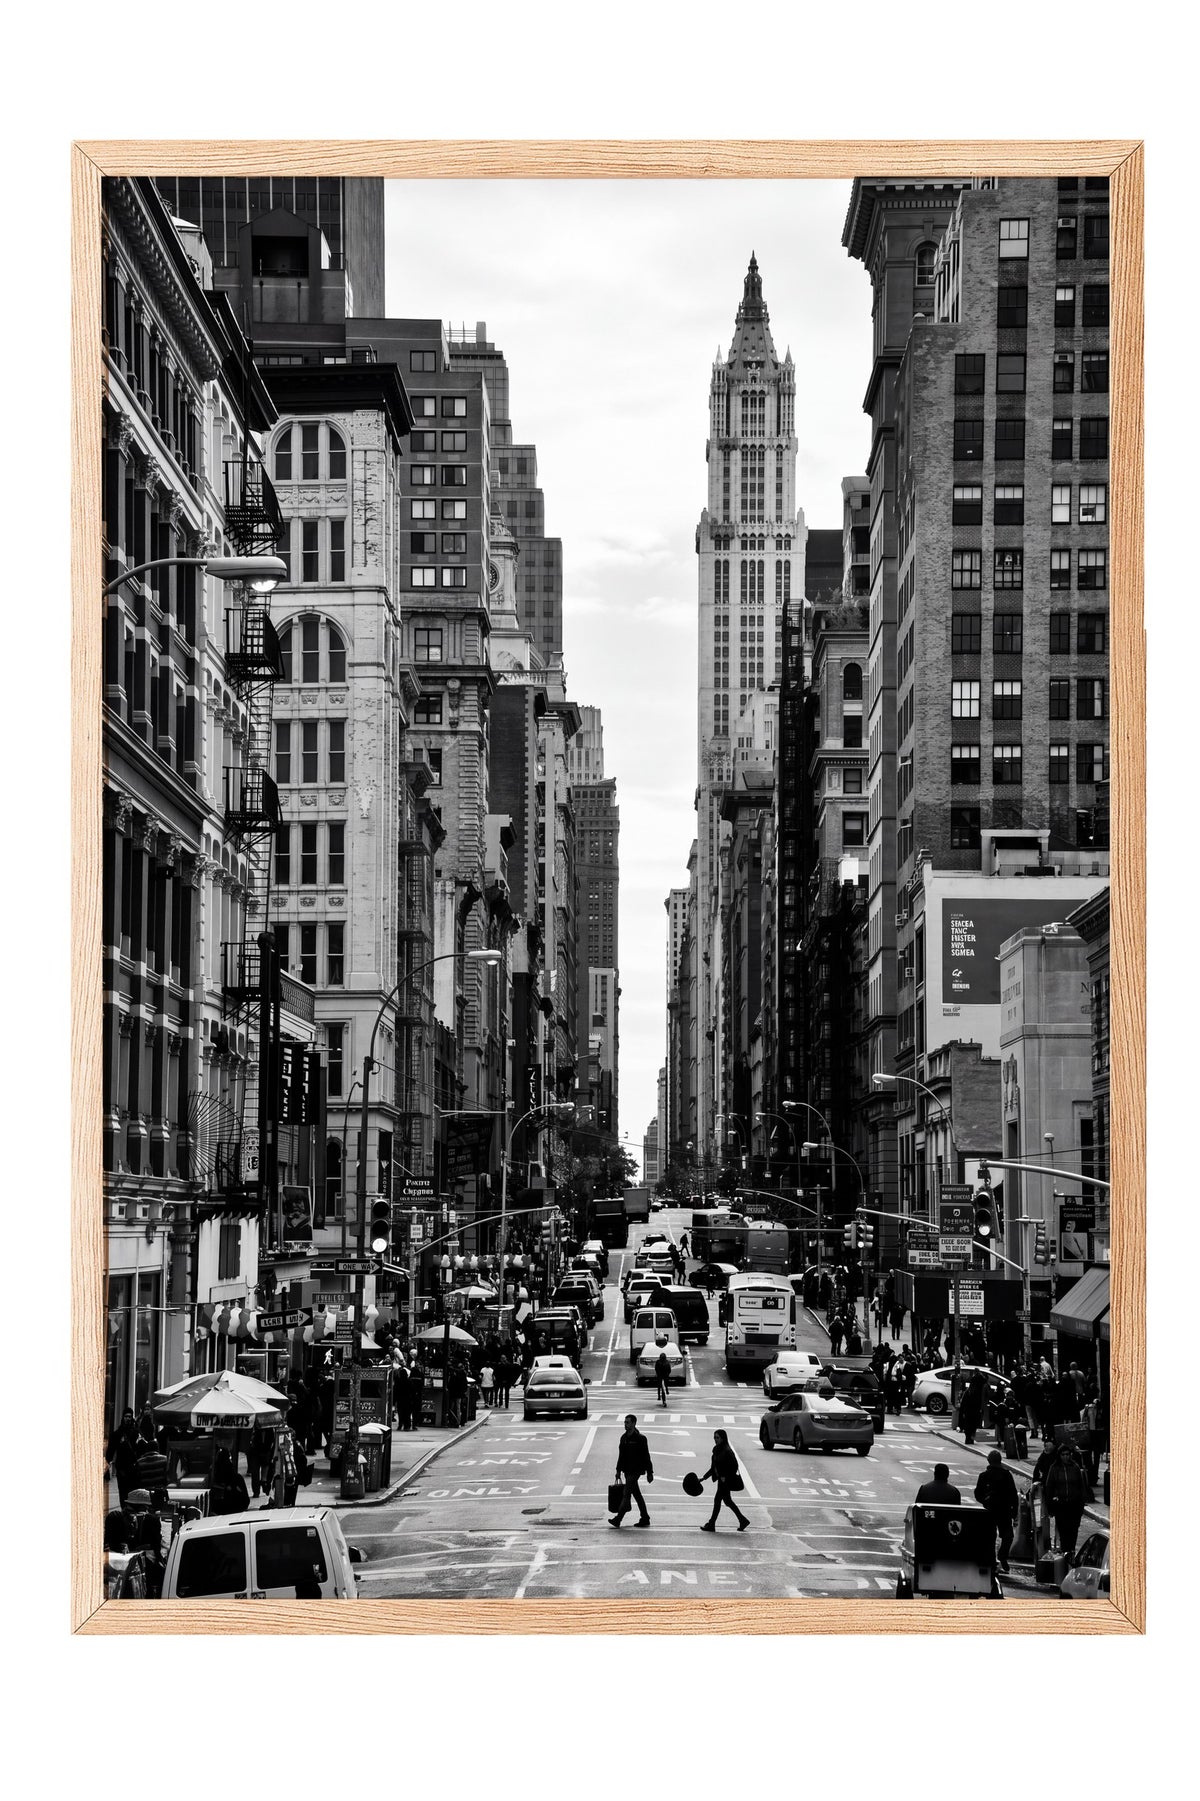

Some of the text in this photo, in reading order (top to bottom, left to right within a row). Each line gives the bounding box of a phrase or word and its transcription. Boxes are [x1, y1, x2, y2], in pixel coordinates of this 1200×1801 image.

[342, 1262, 376, 1271] ONE WAY
[456, 1457, 552, 1466] ONLY
[778, 1477, 873, 1486] ONLY
[427, 1485, 540, 1498] ONLY
[788, 1487, 877, 1497] BUS
